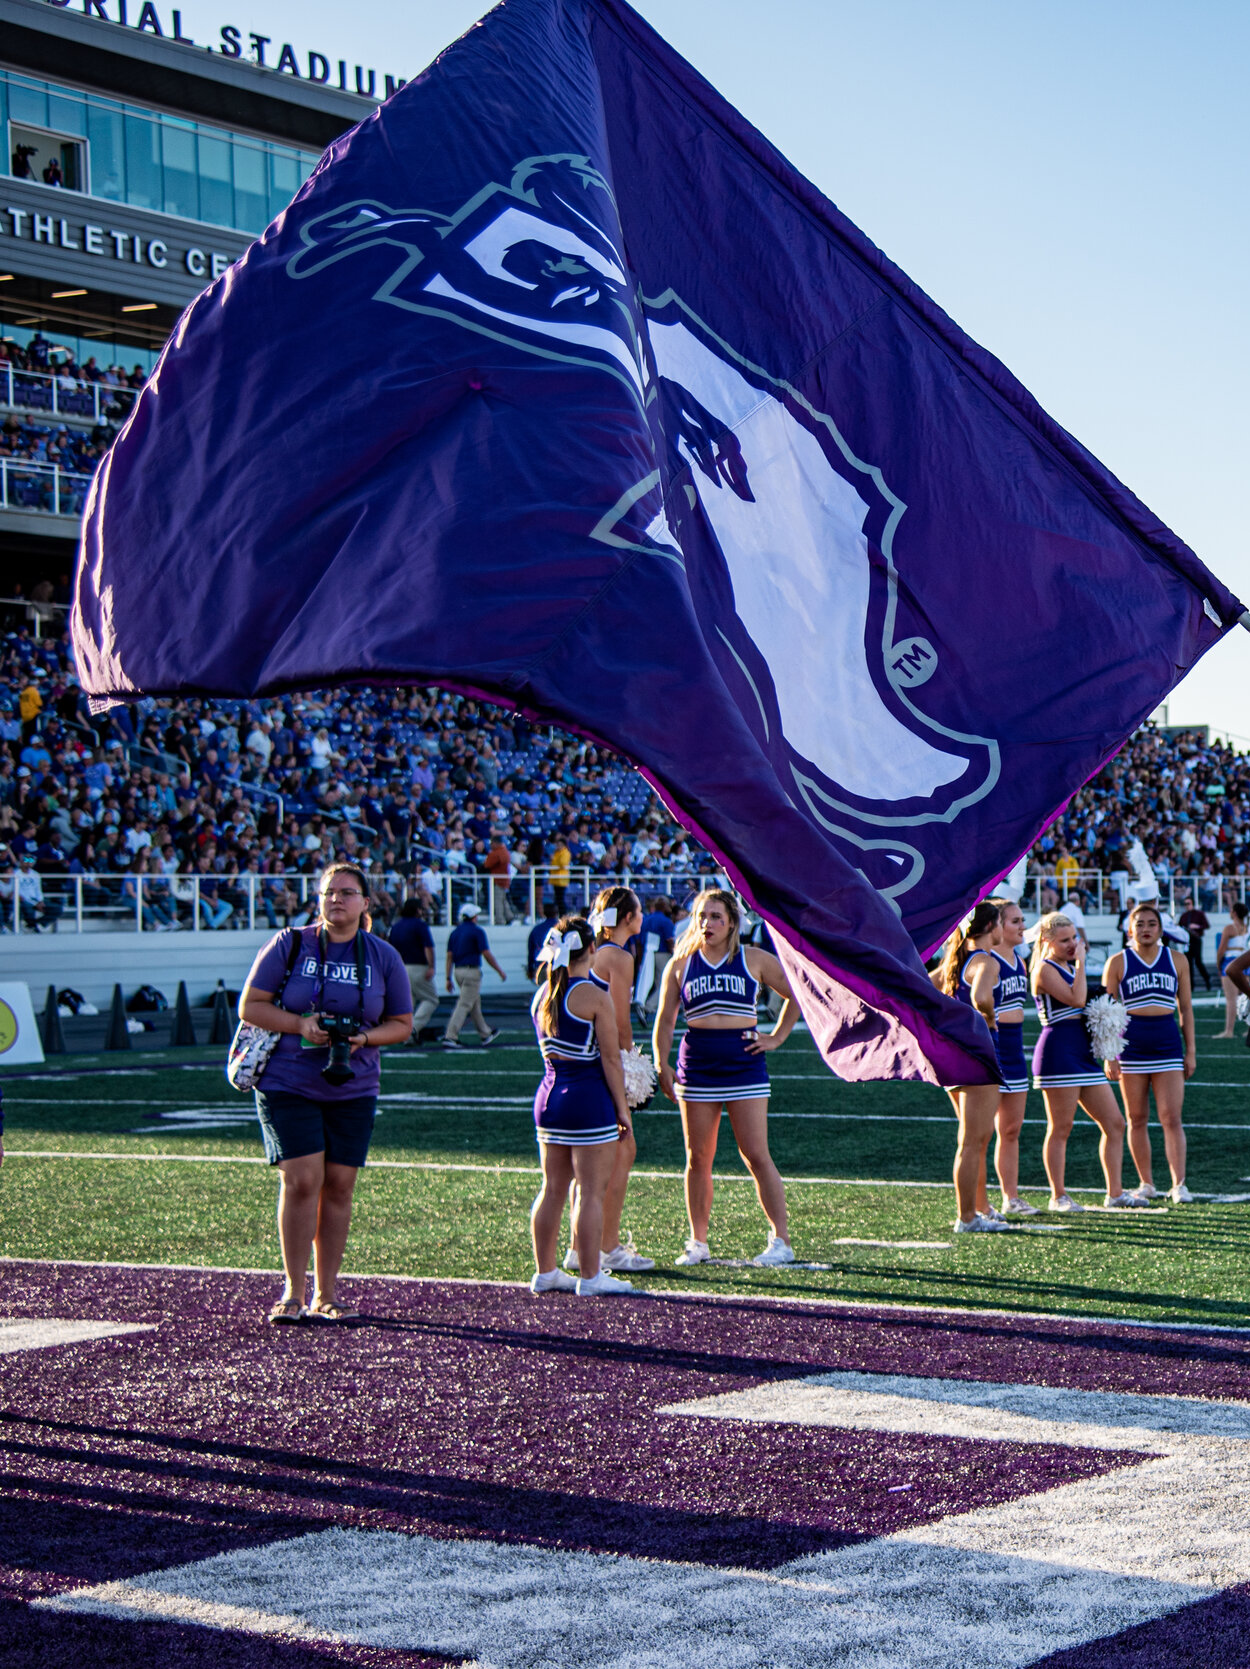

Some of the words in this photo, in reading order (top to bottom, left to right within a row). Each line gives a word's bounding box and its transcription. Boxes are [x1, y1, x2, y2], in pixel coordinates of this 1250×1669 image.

[49, 0, 194, 46] RIAL
[0, 206, 168, 269] THLETIC
[186, 248, 232, 281] CE
[891, 643, 931, 679] TM
[1126, 973, 1175, 995] TARLETON
